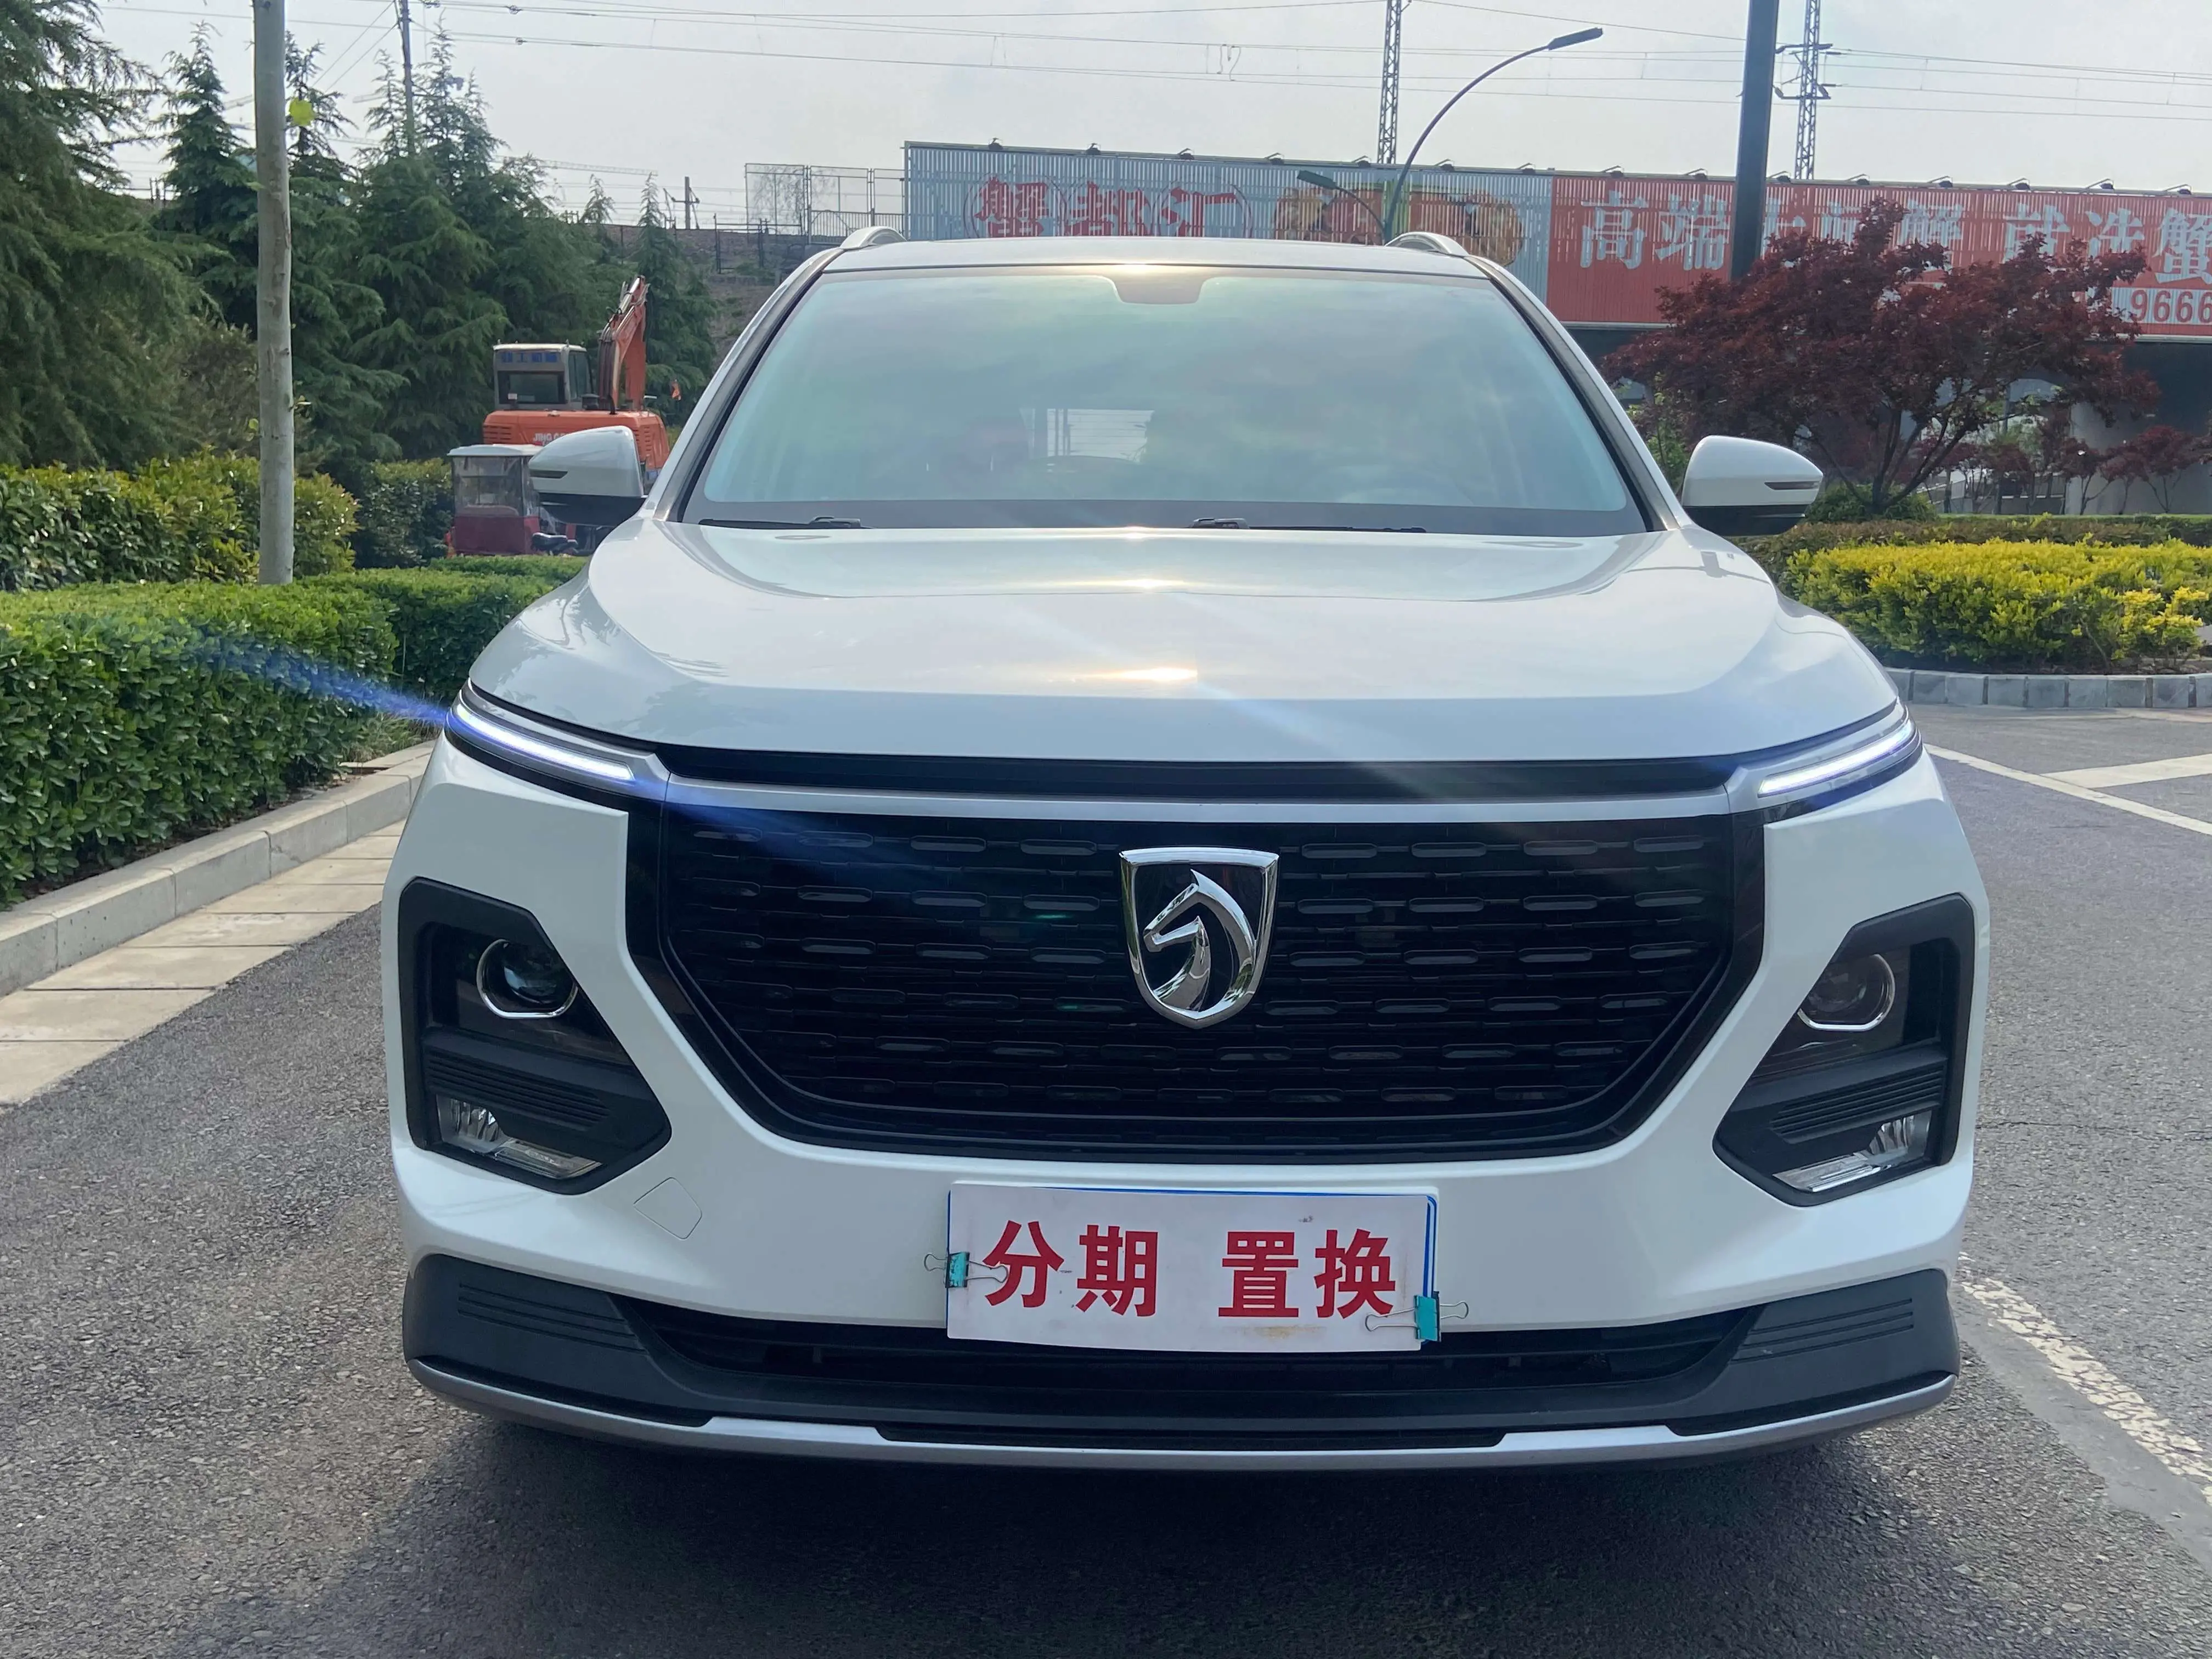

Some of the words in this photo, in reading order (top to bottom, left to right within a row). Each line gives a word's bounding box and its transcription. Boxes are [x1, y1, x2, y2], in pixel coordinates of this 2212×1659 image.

[2131, 289, 2212, 323] 9666
[983, 1220, 1159, 1316] 分期
[1218, 1228, 1396, 1319] 置换
